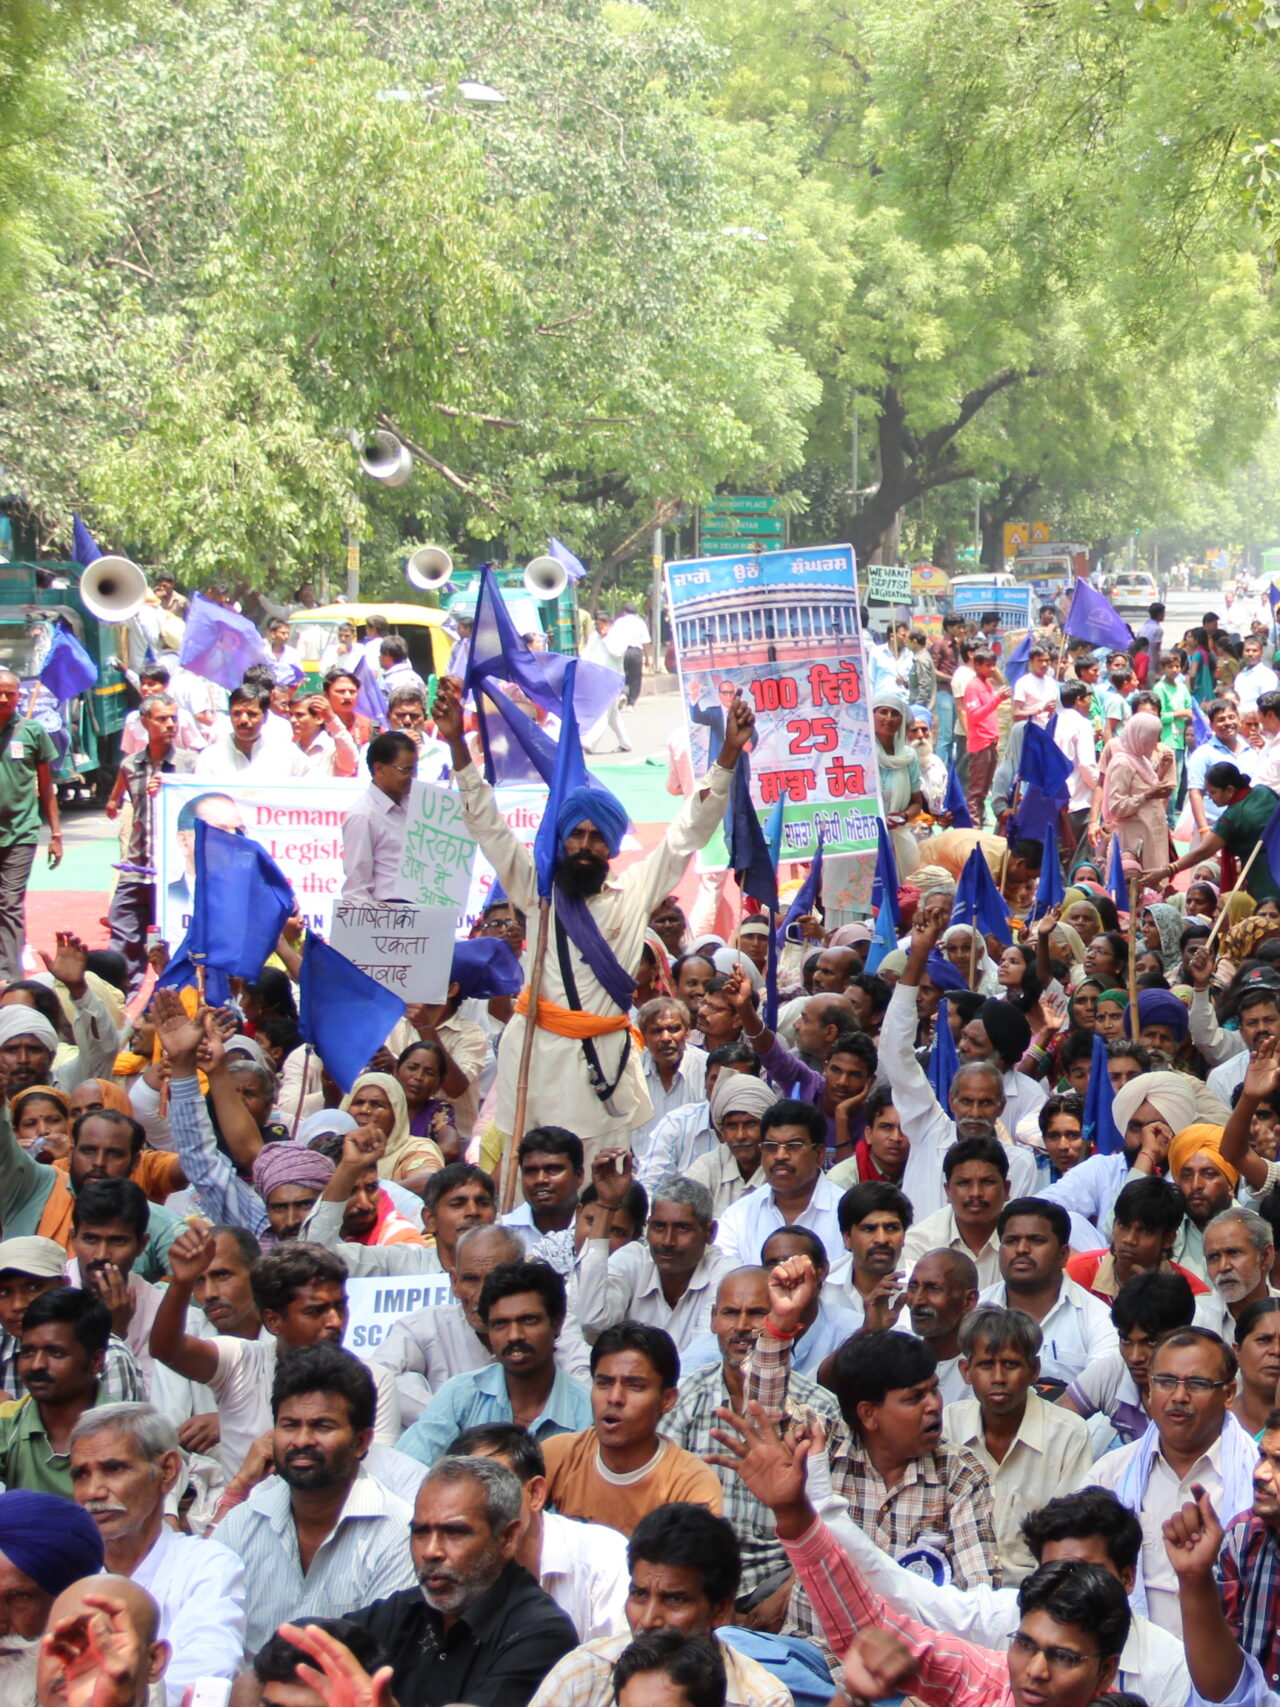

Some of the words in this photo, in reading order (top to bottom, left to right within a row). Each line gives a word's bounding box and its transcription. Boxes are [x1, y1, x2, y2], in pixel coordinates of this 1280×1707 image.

[869, 567, 883, 577] WE
[884, 568, 910, 578] WANT
[750, 677, 799, 712] 100
[786, 717, 839, 755] 25
[303, 872, 338, 894] the
[371, 935, 430, 956] एकता
